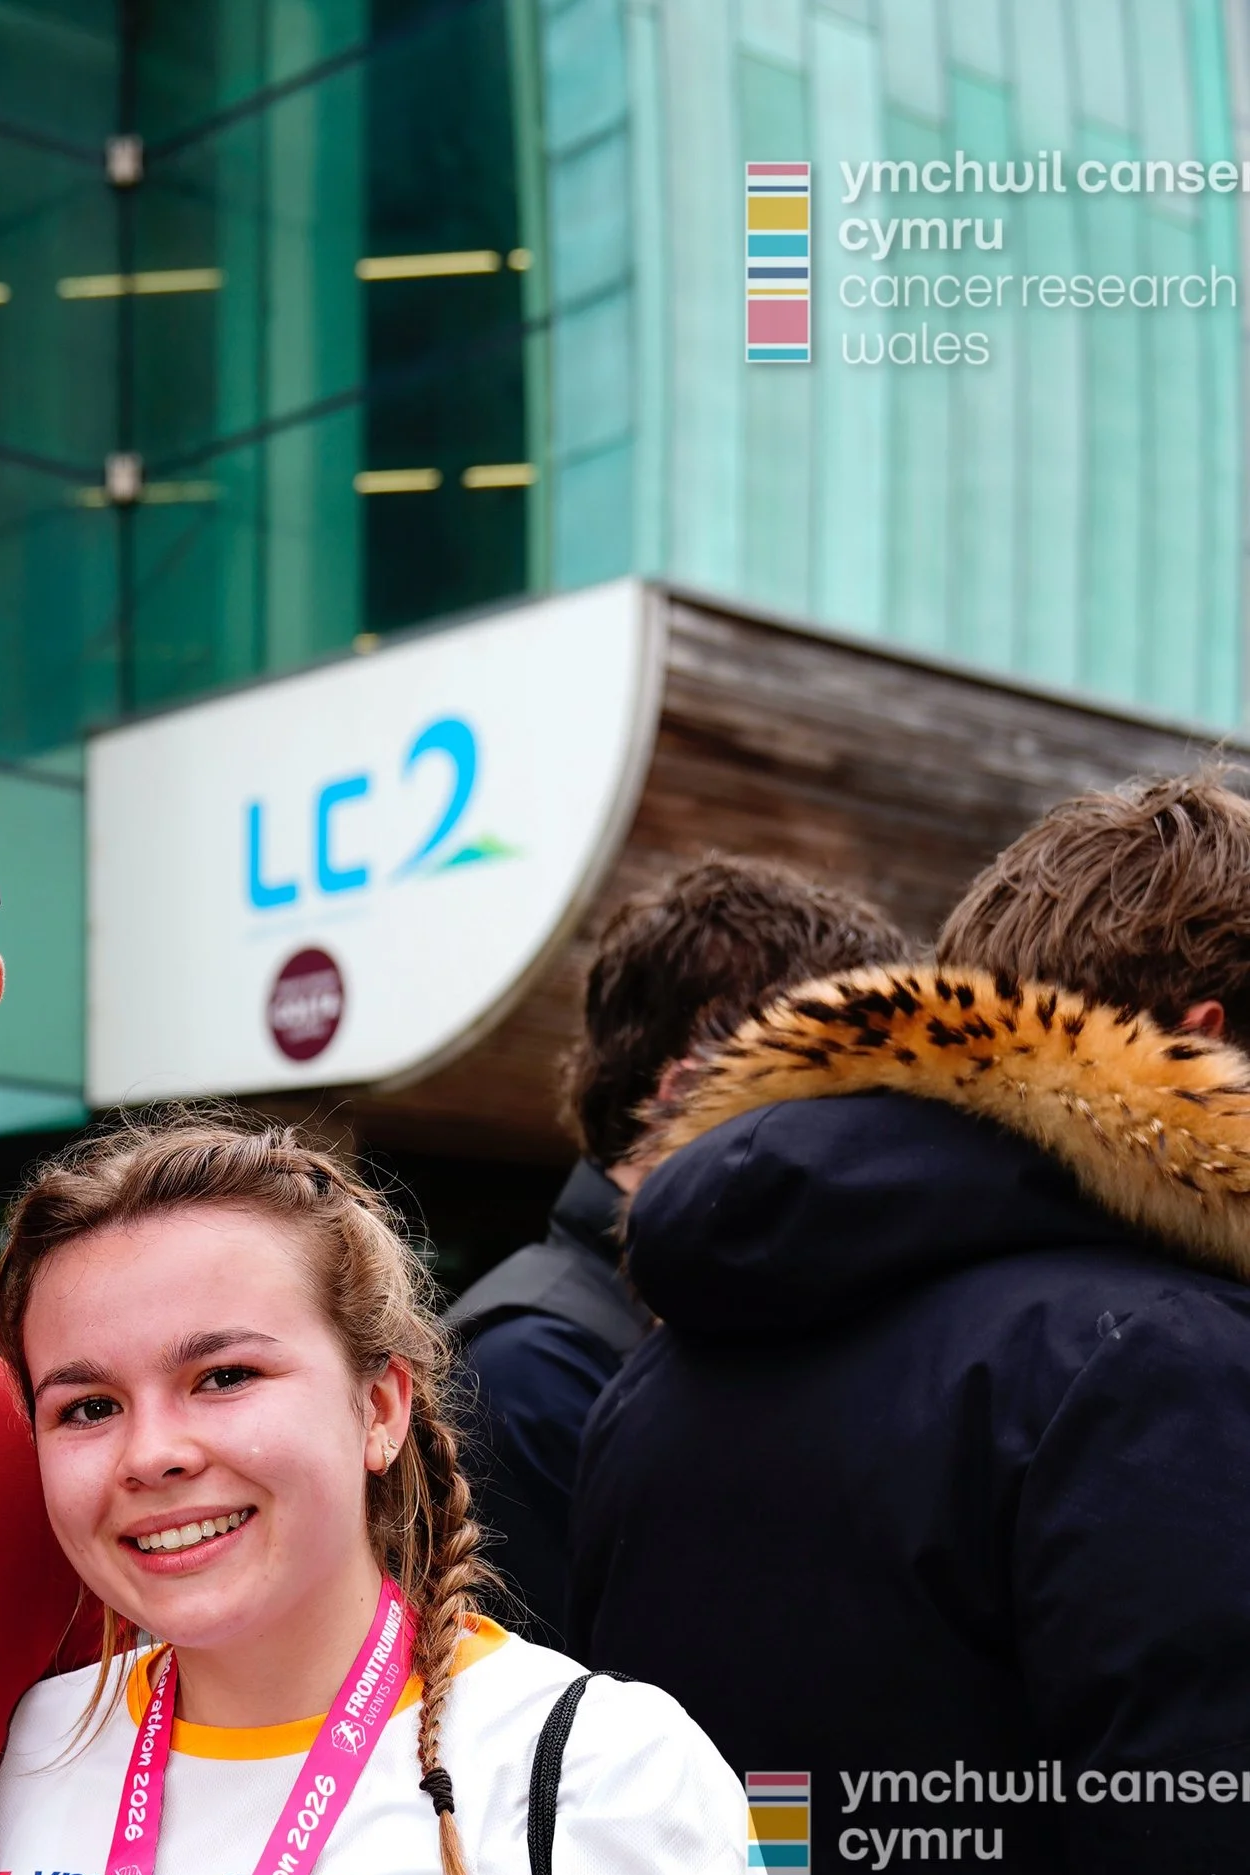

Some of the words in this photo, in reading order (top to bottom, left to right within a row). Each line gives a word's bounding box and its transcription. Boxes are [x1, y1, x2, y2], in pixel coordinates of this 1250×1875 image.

[249, 718, 477, 909] LC2
[344, 1599, 403, 1719] FRONTRUNNER
[363, 1683, 391, 1726] EVENTS
[385, 1662, 400, 1685] LTD
[124, 1771, 150, 1842] 2026
[287, 1774, 336, 1851] 2026
